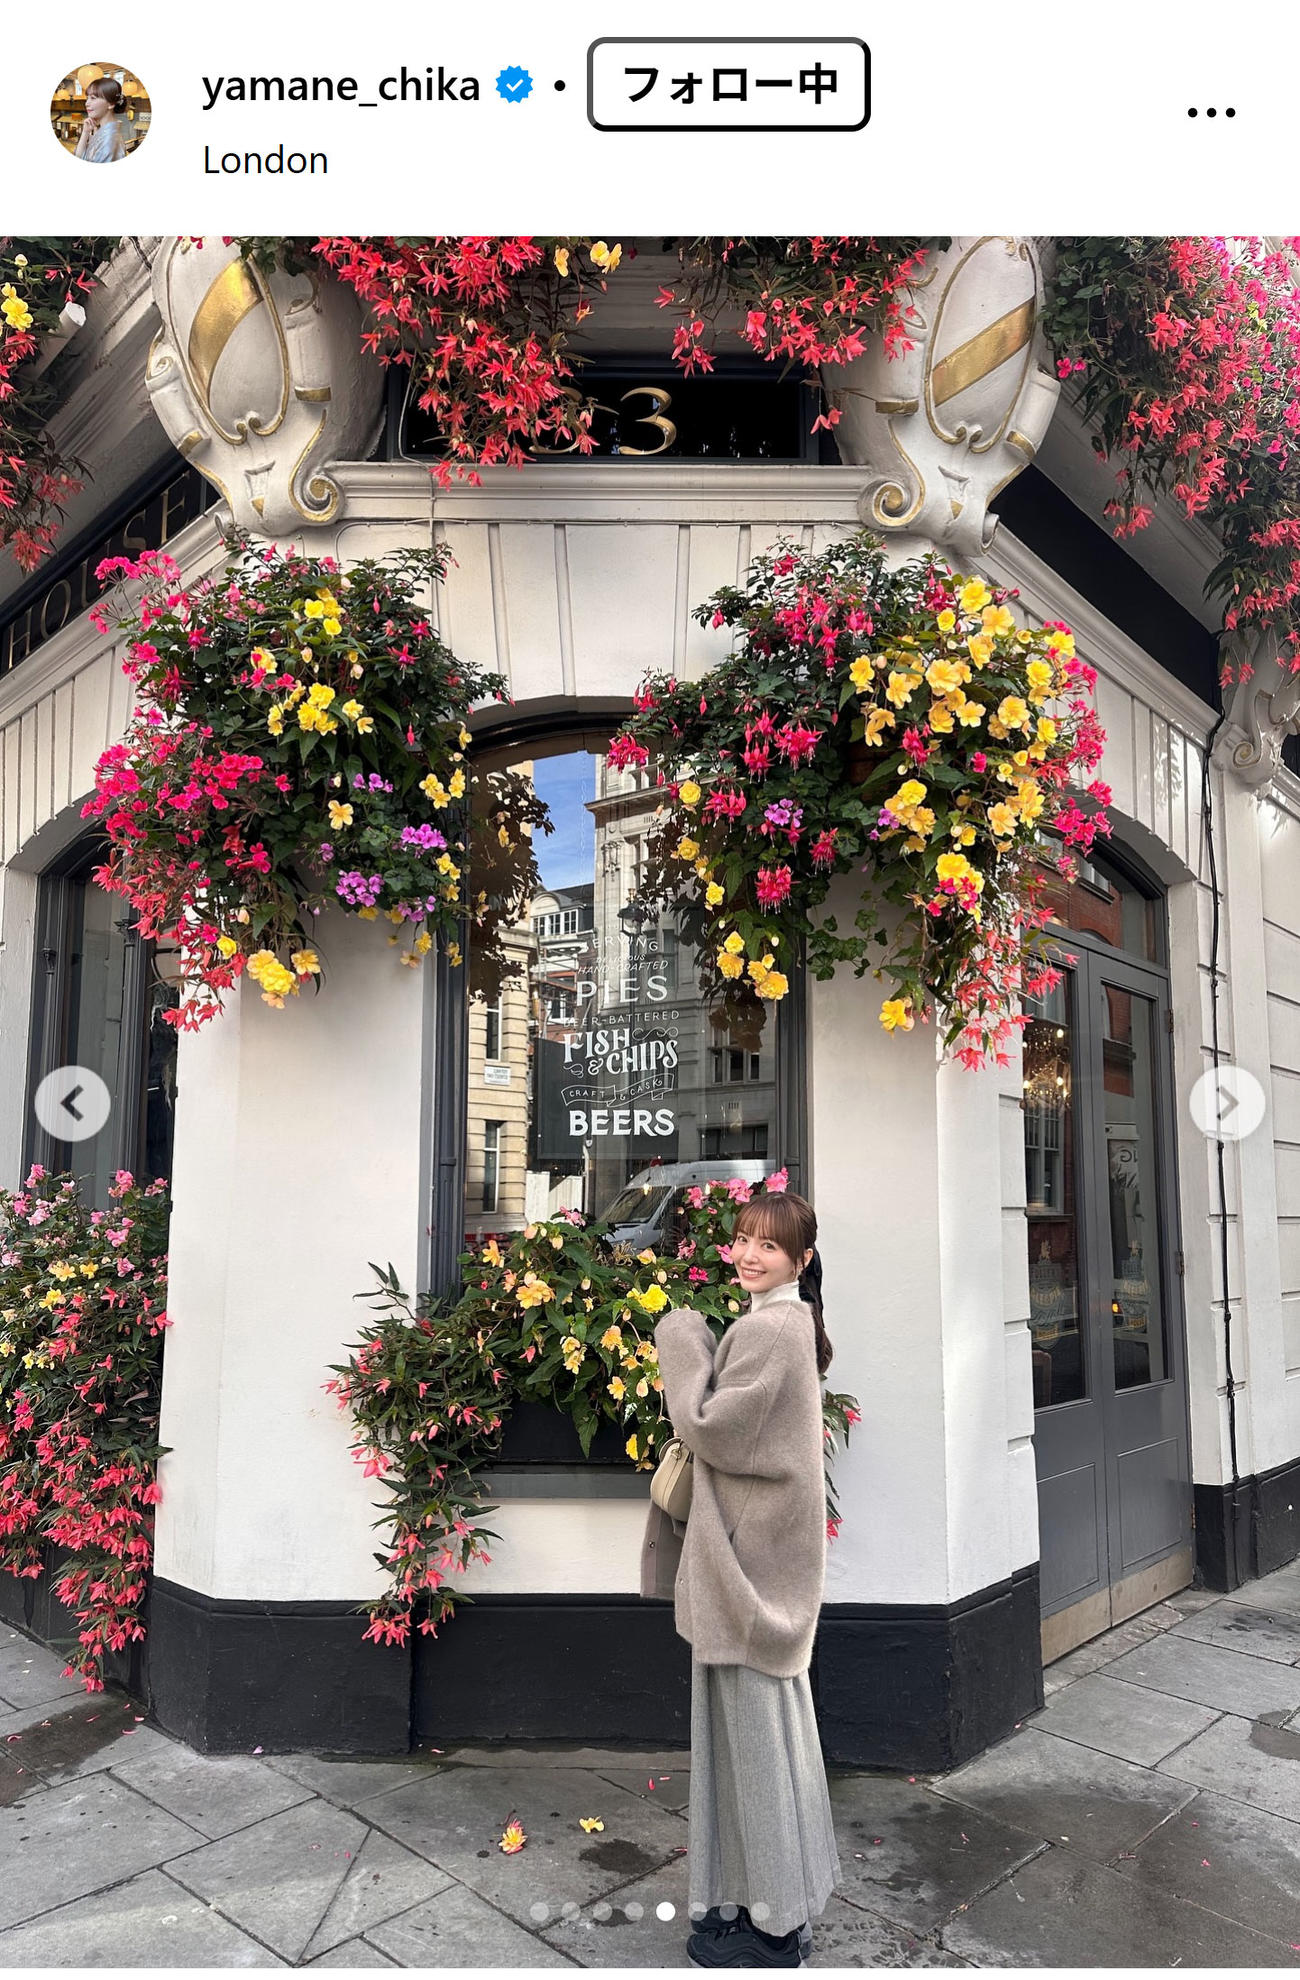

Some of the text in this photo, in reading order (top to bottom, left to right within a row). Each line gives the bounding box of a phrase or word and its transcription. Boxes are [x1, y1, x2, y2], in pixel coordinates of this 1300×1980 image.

[576, 975, 668, 1006] PIES
[563, 1028, 631, 1064] FISH
[588, 1040, 678, 1076] & CHIPS
[569, 1089, 606, 1098] CRAFT
[630, 1078, 664, 1097] CASK
[569, 1108, 676, 1138] BEERS
